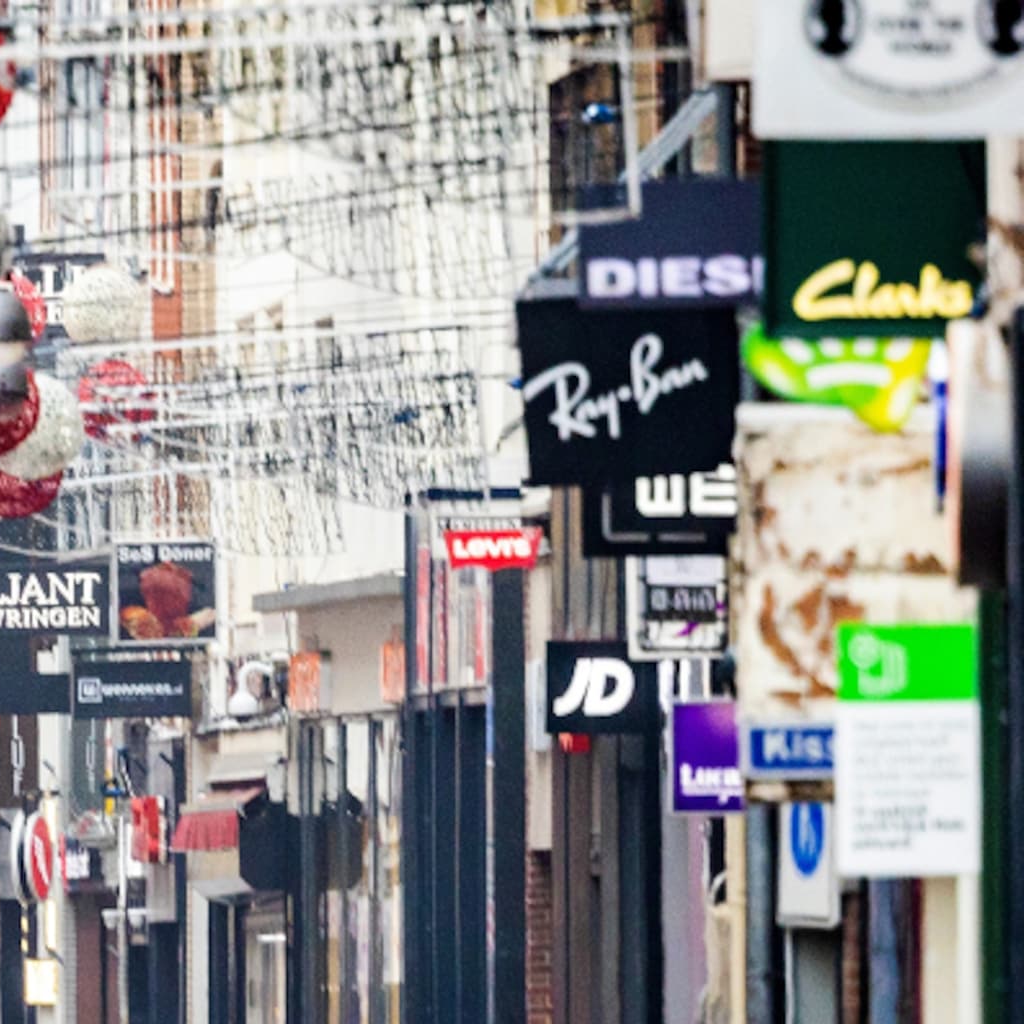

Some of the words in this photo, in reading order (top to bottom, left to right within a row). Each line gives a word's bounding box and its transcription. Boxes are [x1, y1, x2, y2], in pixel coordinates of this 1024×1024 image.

[586, 254, 764, 299] DIES
[791, 257, 975, 321] Clarks
[552, 657, 635, 717] JD
